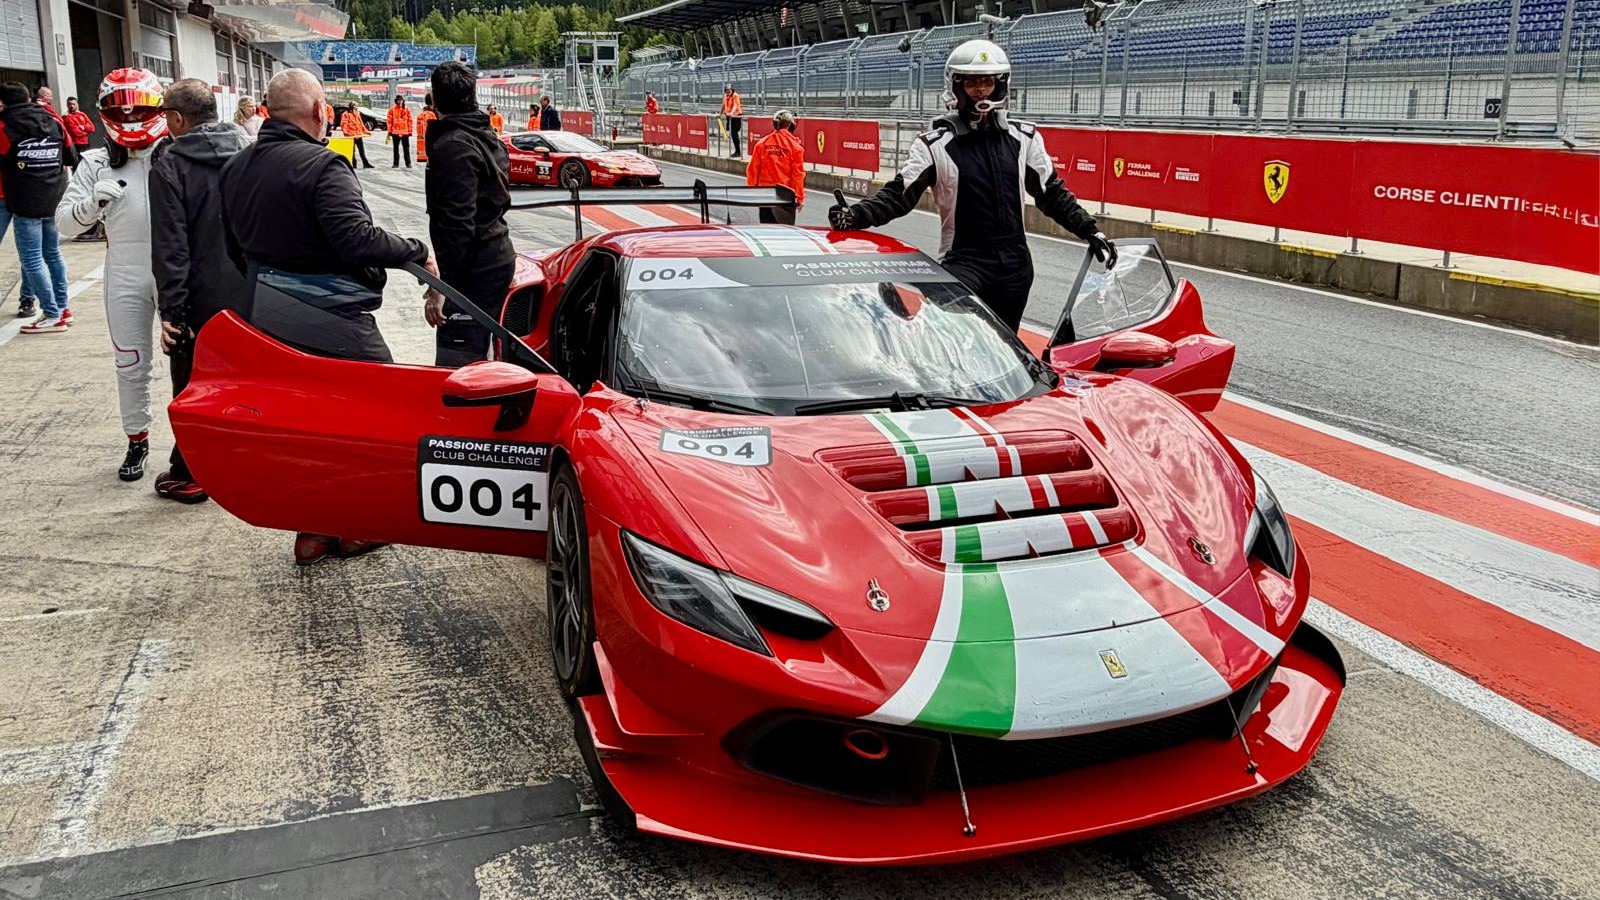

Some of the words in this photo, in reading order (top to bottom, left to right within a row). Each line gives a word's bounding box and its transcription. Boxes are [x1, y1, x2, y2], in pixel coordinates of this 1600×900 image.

[1486, 103, 1501, 114] 07
[539, 166, 549, 175] 33
[1127, 162, 1151, 170] FERRARI
[1127, 169, 1160, 179] CHALLENGE
[1374, 185, 1436, 203] CORSE
[1439, 191, 1519, 211] CLIENTI
[782, 261, 871, 270] PASSIONE
[872, 260, 931, 268] FERRARI
[639, 268, 693, 282] 004
[796, 268, 847, 277] CLUB
[849, 267, 937, 276] CHALLENGE
[428, 439, 491, 452] PASSIONE
[494, 444, 547, 456] FERRARI
[678, 439, 755, 459] 004
[433, 450, 465, 460] CLUB
[468, 452, 541, 466] CHALLENGE
[430, 475, 541, 521] 004
